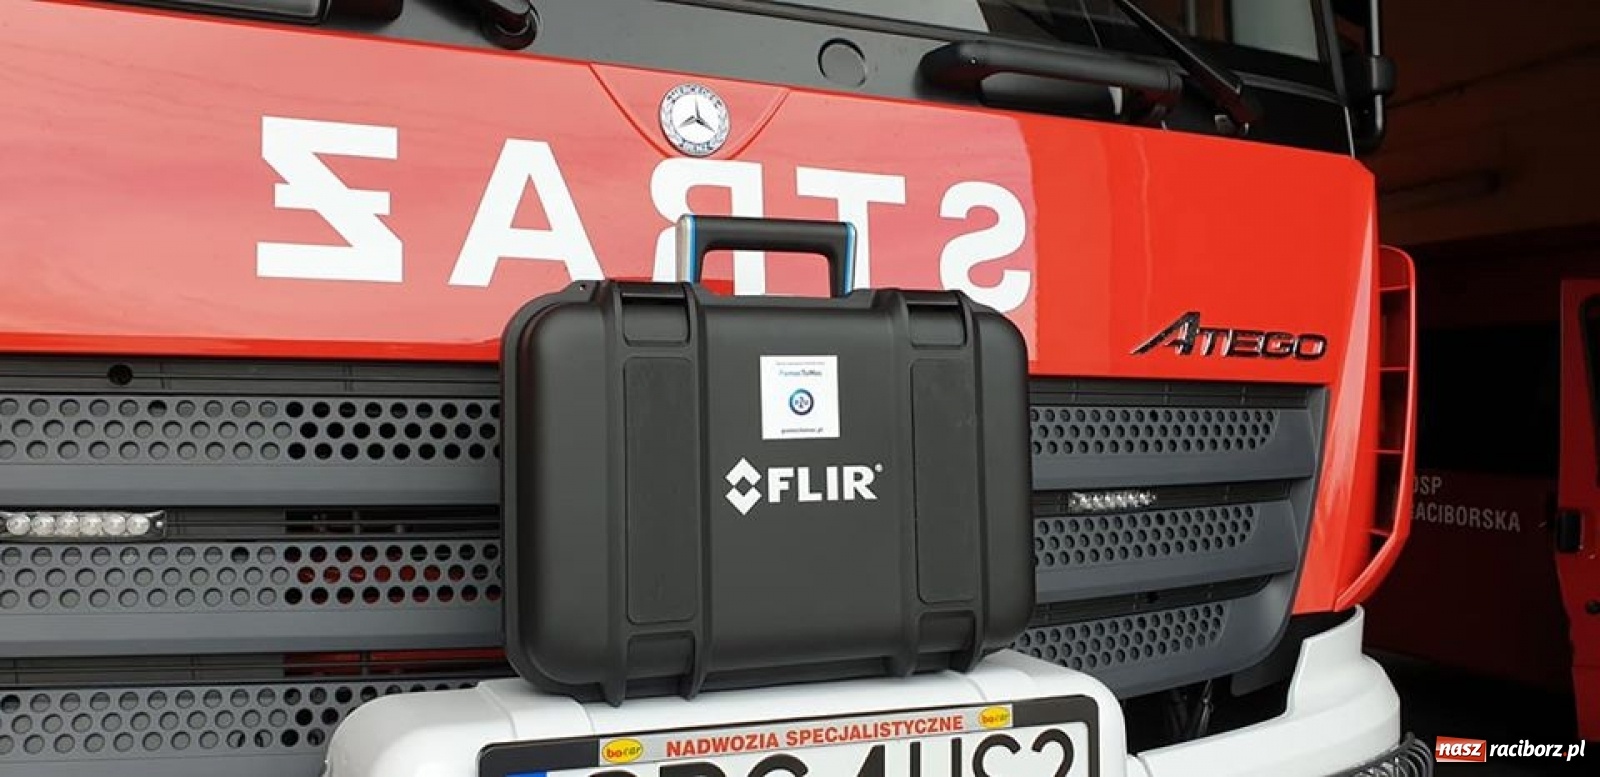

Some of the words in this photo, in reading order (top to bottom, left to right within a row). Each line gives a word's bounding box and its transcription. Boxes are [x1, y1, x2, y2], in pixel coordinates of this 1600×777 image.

[1130, 311, 1327, 361] ATEGO
[666, 732, 779, 757] NADWOZIA
[786, 715, 964, 746] SPECJALISTYCZNE
